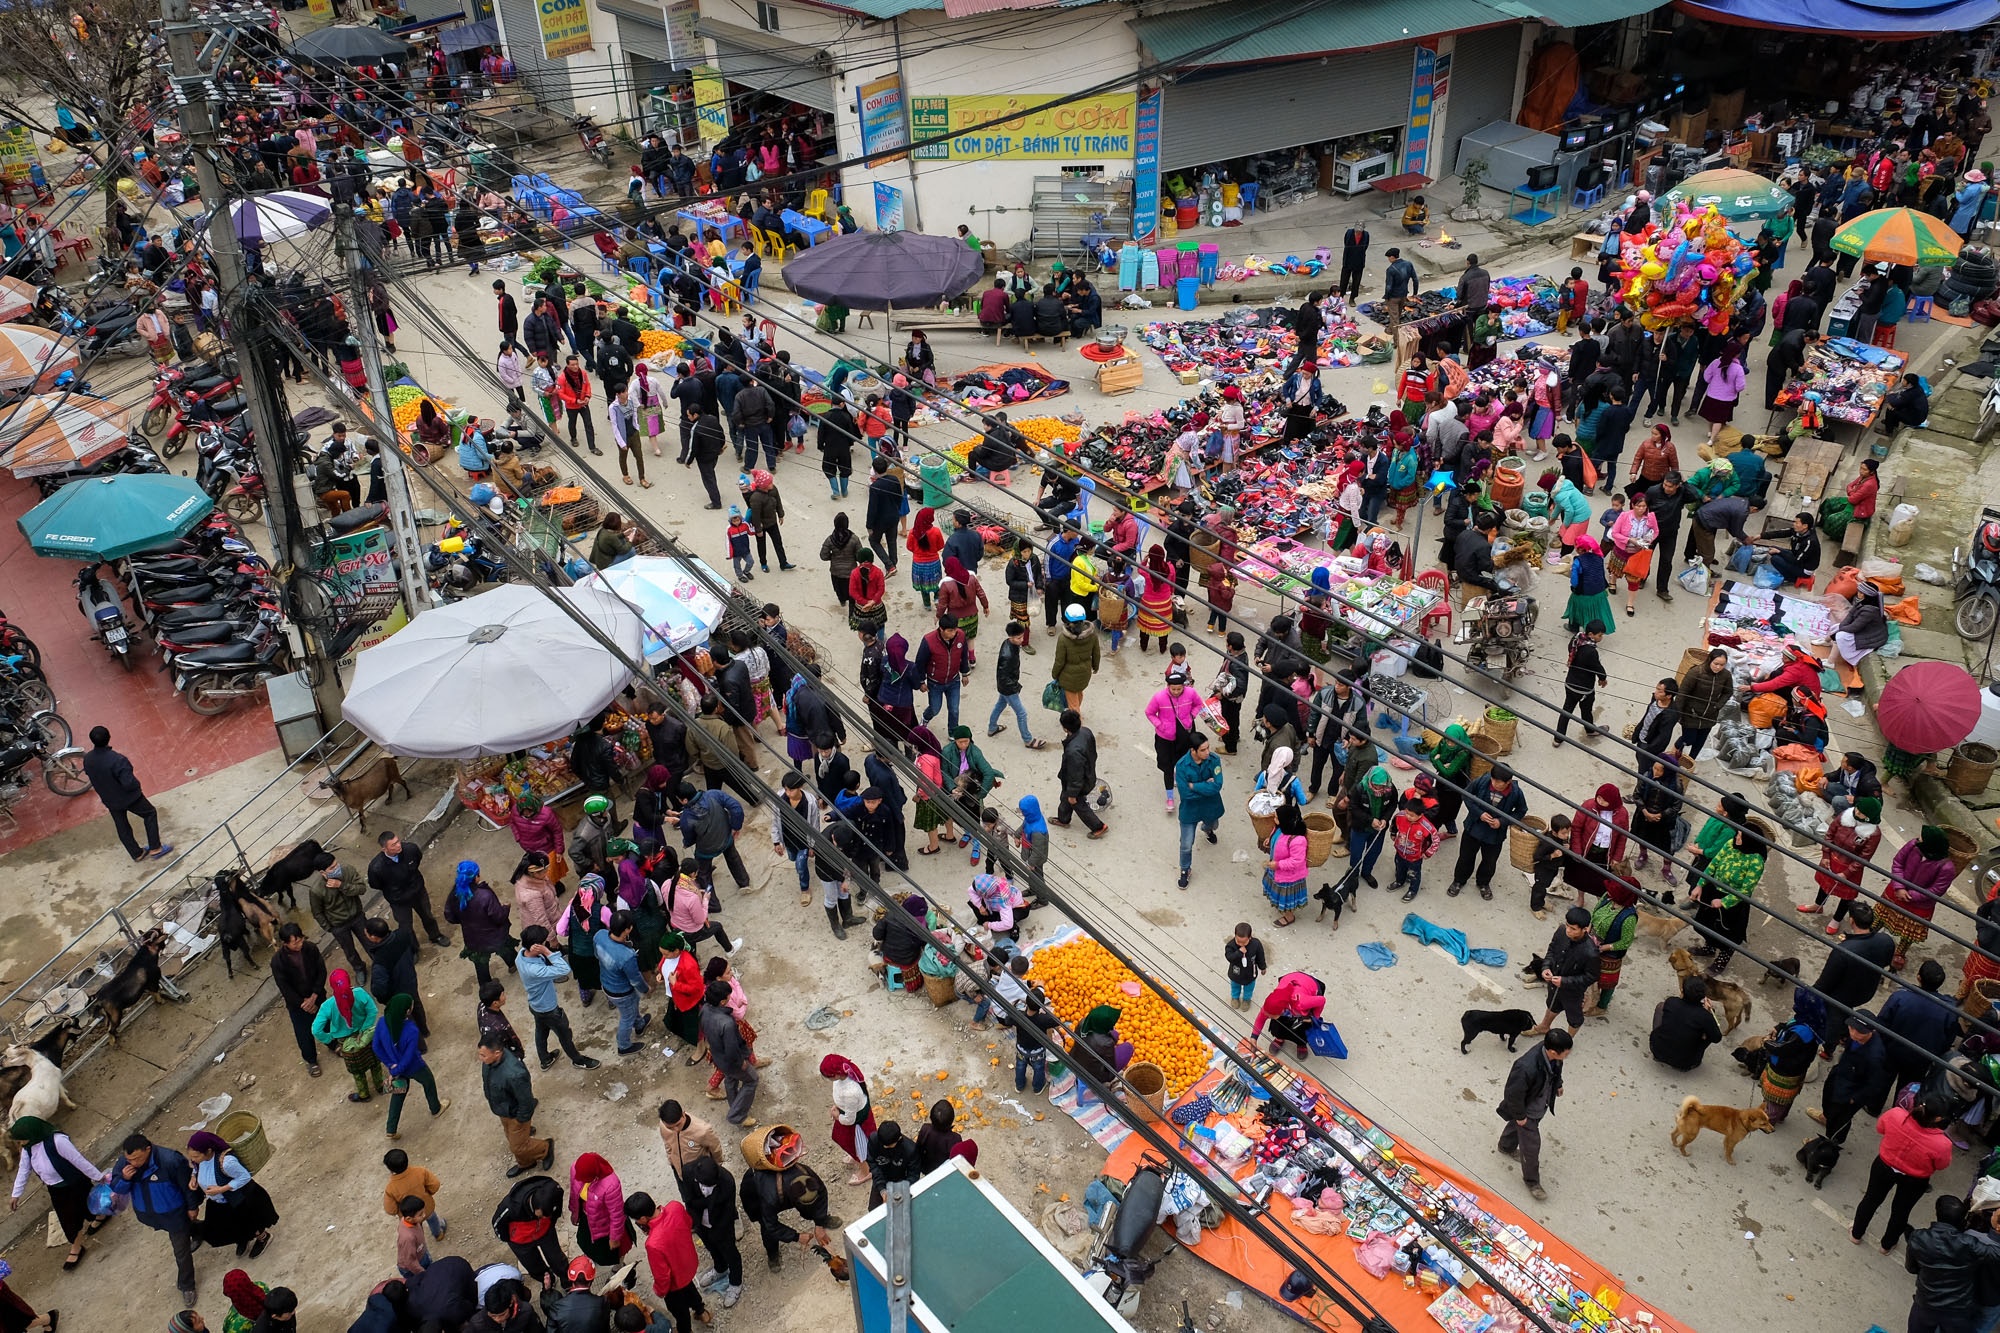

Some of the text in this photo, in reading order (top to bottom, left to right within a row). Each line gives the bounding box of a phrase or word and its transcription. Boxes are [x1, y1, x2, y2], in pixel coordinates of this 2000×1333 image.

[1054, 103, 1129, 130] CƠM
[954, 136, 981, 154] CƠM
[984, 135, 1016, 156] ĐẶT
[1023, 134, 1059, 154] BÁNH
[1063, 134, 1082, 156] TỰ
[1083, 133, 1129, 153] TRÁNG
[174, 495, 197, 515] CREDIT
[59, 534, 96, 543] CREDIT
[371, 623, 383, 633] Xe
[361, 637, 380, 648] Tem
